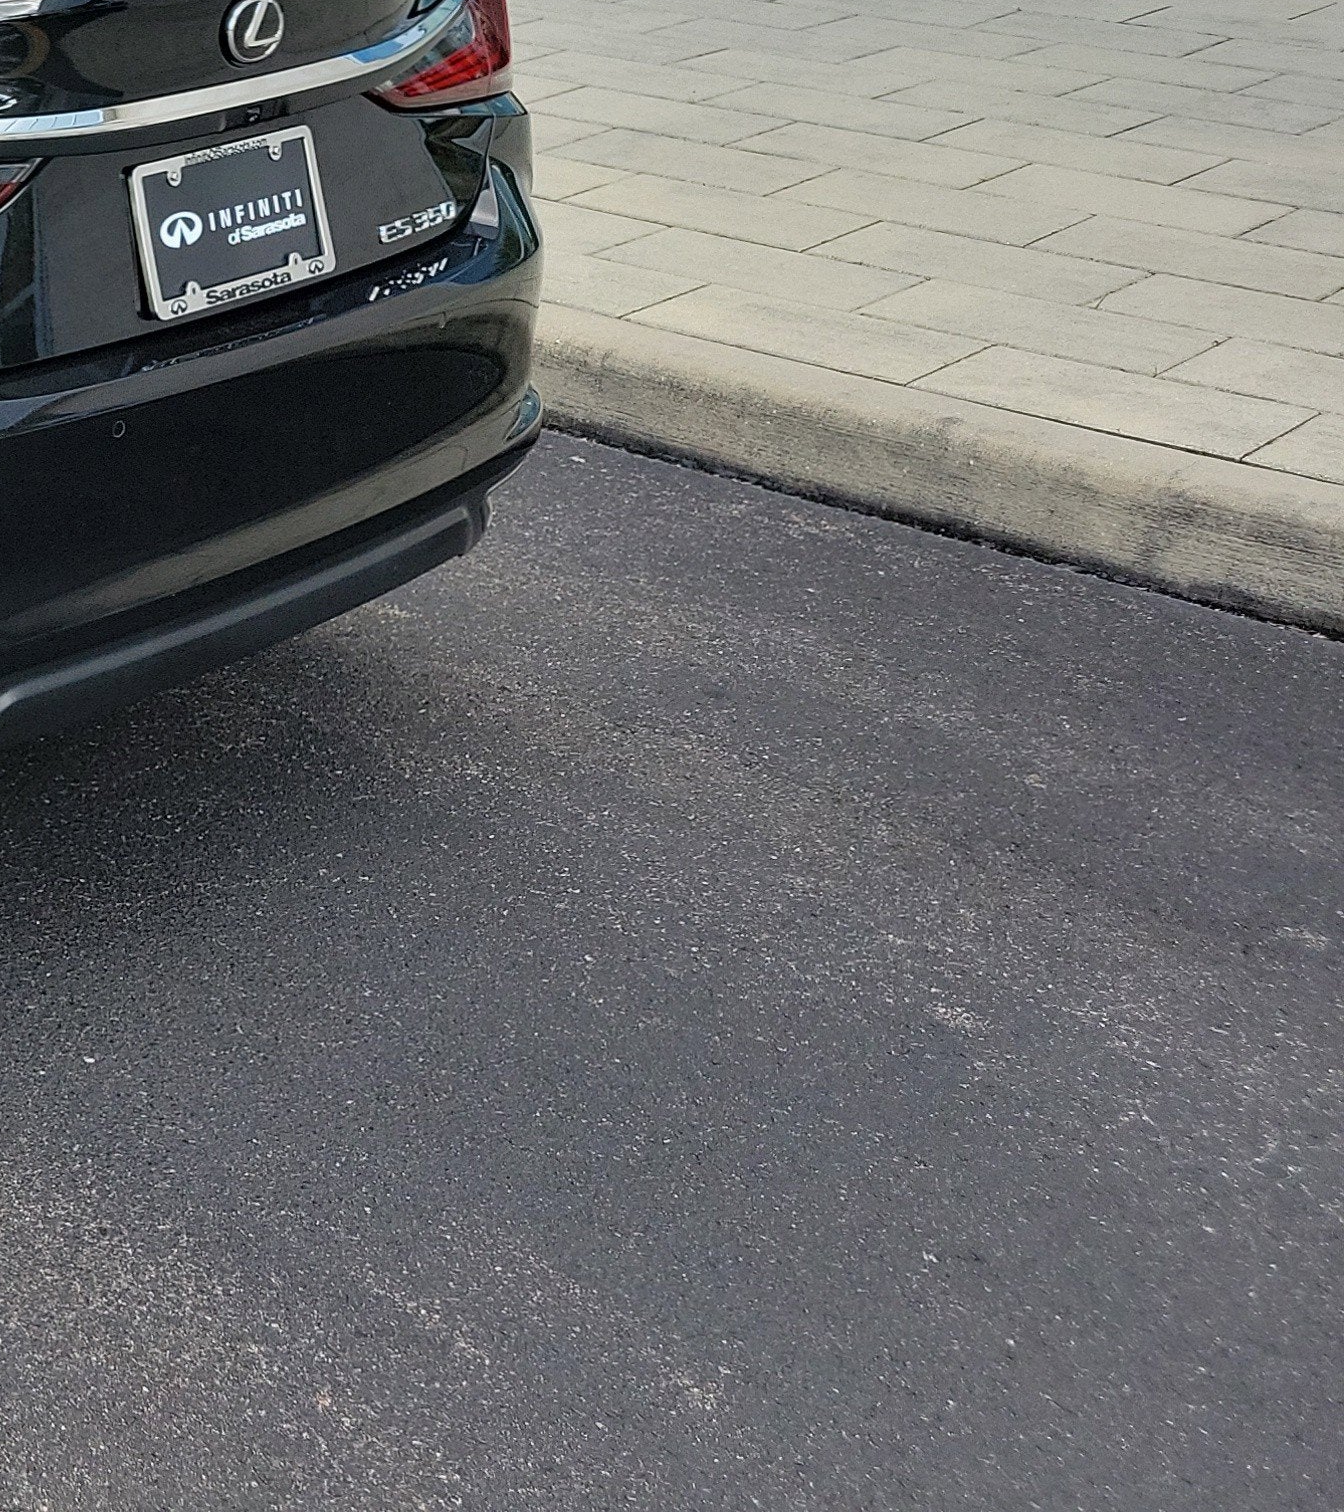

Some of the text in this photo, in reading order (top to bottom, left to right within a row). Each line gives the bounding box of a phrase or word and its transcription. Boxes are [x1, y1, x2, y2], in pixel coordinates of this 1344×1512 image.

[208, 188, 303, 232] INFINITI
[240, 212, 306, 242] Sarasota
[379, 201, 457, 243] ES 350
[205, 271, 292, 305] Sarasota
